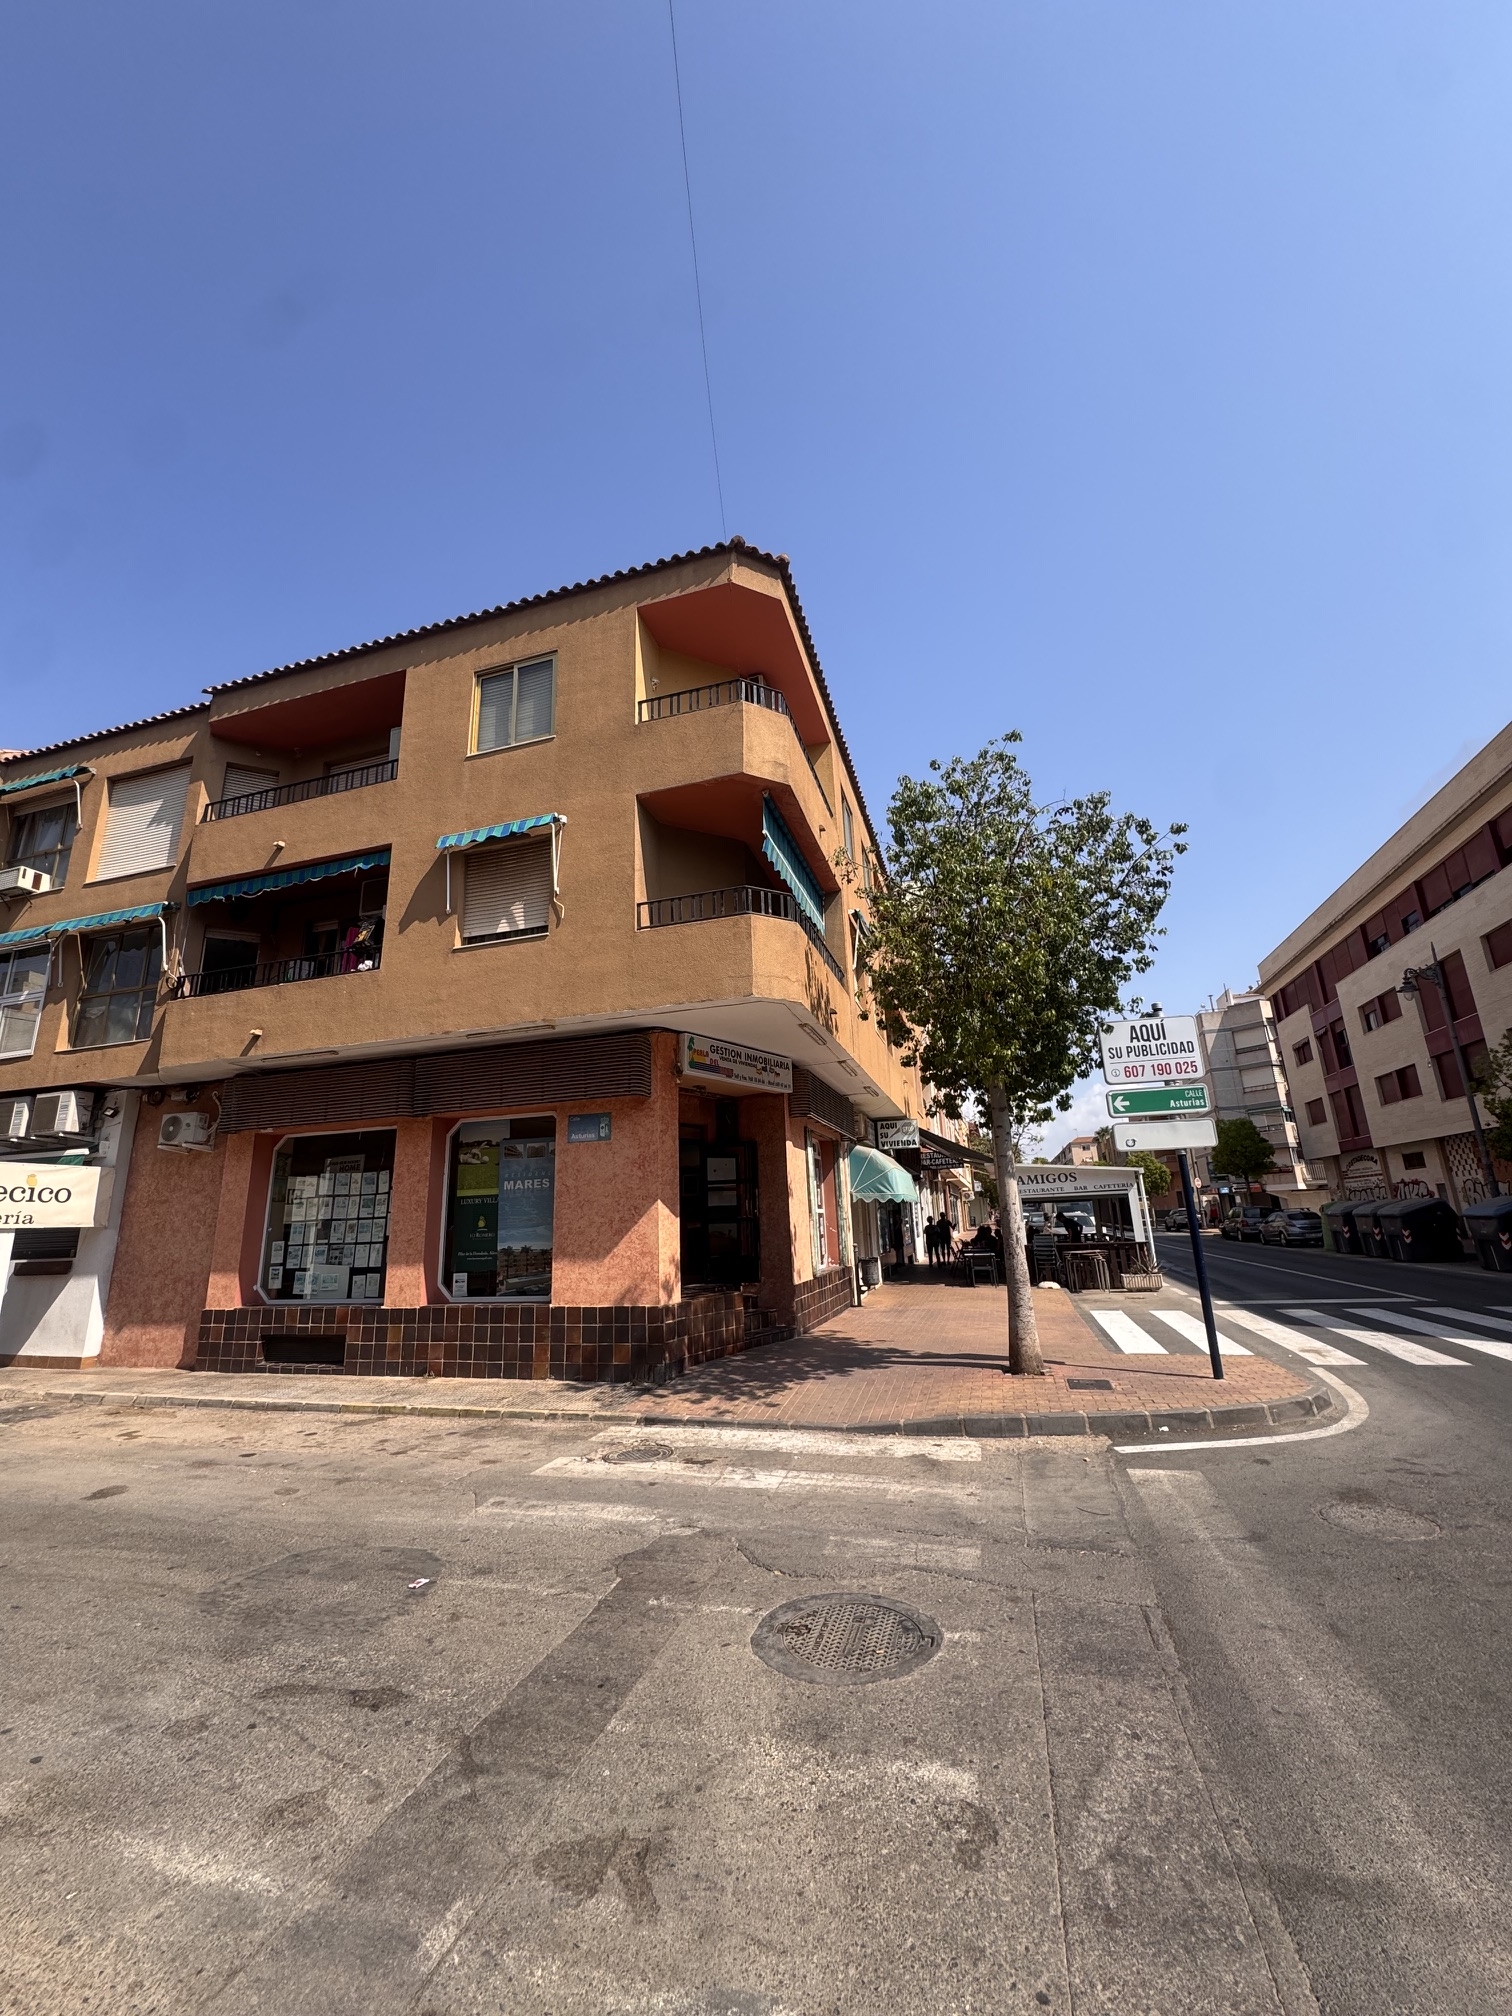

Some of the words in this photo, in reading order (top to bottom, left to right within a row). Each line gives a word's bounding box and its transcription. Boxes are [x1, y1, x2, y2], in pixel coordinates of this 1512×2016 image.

[1129, 1018, 1167, 1043] AQUÍ
[1107, 1046, 1123, 1060] SU
[1125, 1040, 1195, 1058] PUBLICIDAD
[709, 1044, 742, 1060] GESTION
[744, 1051, 791, 1071] INMOBILIARIA
[709, 1057, 720, 1066] DEL
[719, 1055, 732, 1063] VENTA
[1123, 1064, 1146, 1079] 607
[1150, 1062, 1173, 1077] 190
[1174, 1060, 1199, 1075] 025
[1184, 1089, 1204, 1098] CALLE
[1169, 1098, 1205, 1108] Asturias
[880, 1122, 898, 1130] AQUI
[570, 1131, 596, 1140] Asturias
[880, 1139, 917, 1147] VIVIENDA
[338, 1163, 361, 1172] HOME
[1016, 1172, 1077, 1186] AMIGOS
[504, 1178, 550, 1190] MARES
[1018, 1186, 1065, 1194] ESTAURANTE
[460, 1197, 483, 1205] LUXURY
[0, 1211, 35, 1225] ría
